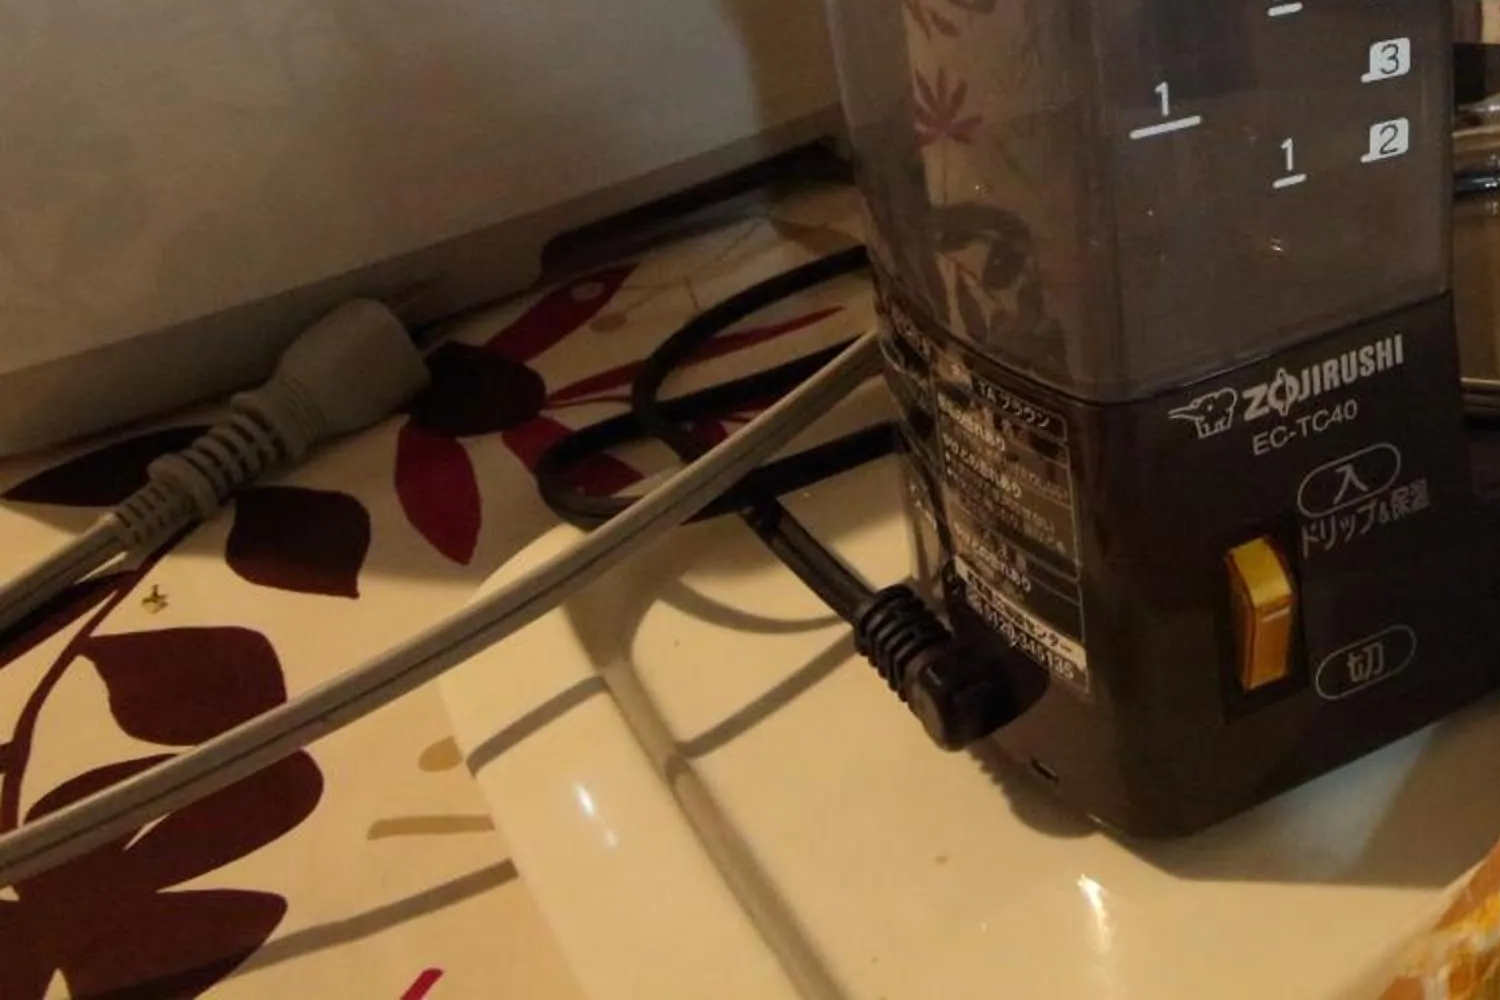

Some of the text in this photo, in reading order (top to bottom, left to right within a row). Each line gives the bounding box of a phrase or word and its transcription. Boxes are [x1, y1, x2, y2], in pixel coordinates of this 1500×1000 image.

[1379, 43, 1400, 75] 3
[1154, 81, 1170, 117] 1
[1279, 137, 1295, 172] 1
[1378, 123, 1400, 155] 2
[1242, 334, 1405, 421] ZOJIRUSHI
[1252, 399, 1359, 456] EC-TC40
[1333, 464, 1369, 506] 入
[1346, 642, 1385, 684] 切
